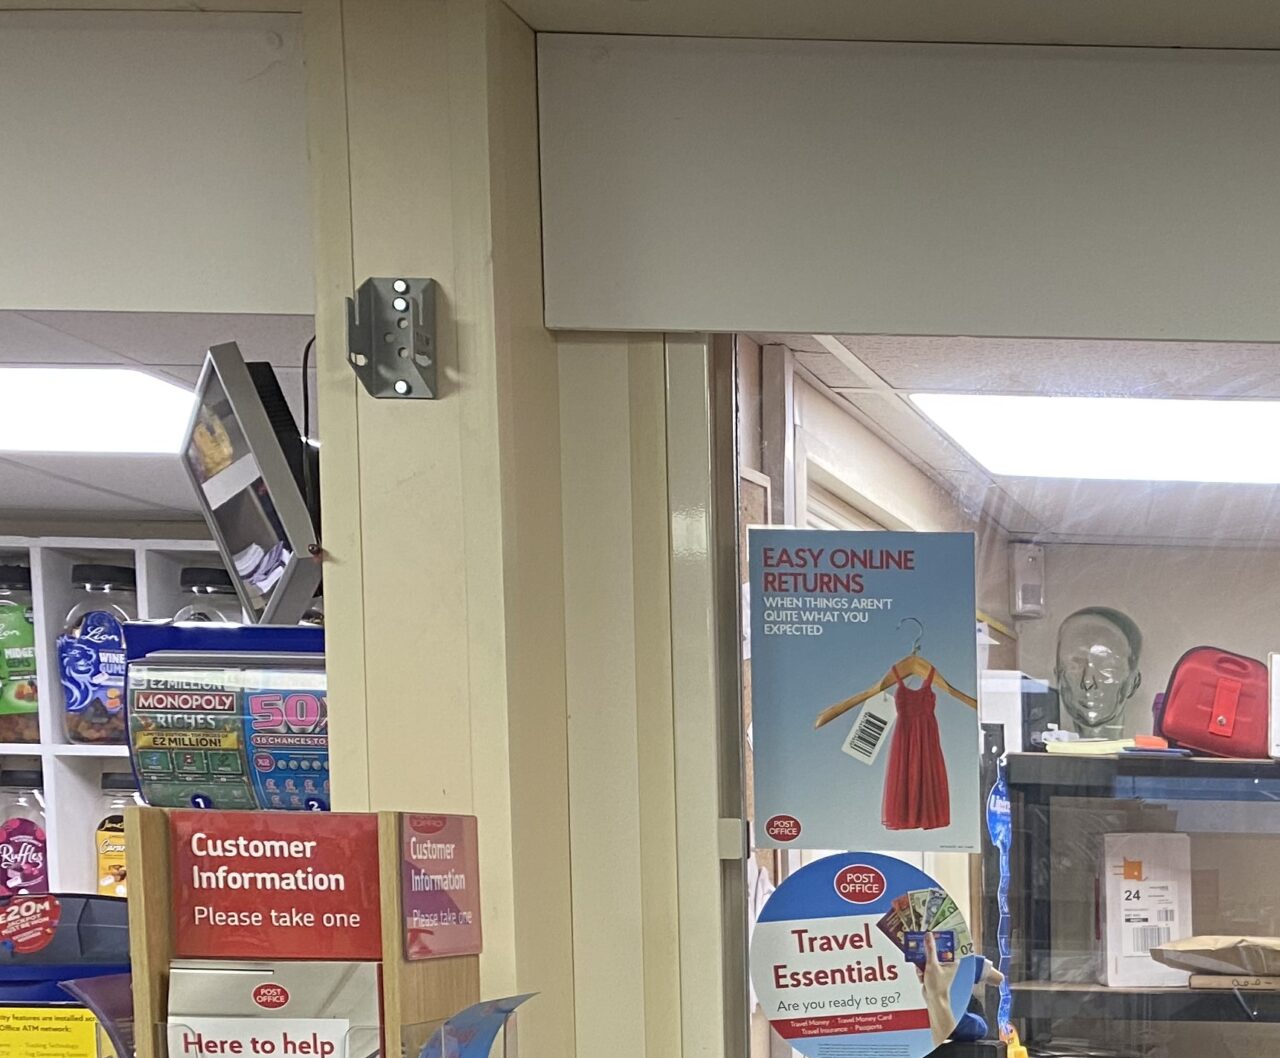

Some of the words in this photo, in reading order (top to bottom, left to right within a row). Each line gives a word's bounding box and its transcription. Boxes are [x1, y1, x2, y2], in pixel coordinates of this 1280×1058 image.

[762, 547, 825, 569] EASY
[829, 548, 916, 571] ONLINE
[762, 572, 865, 595] RETURNS
[763, 597, 802, 610] WHEN
[805, 597, 848, 610] THINGS
[850, 598, 893, 611] AREN'T
[763, 611, 799, 623] QUITE
[800, 611, 840, 624] WHAT
[842, 611, 869, 624] YOU
[81, 627, 120, 644] Lion
[763, 624, 823, 637] EXPECTED
[99, 652, 126, 664] WINE
[137, 694, 234, 711] MONOPOLY
[156, 714, 216, 730] RICHES
[168, 737, 222, 748] MILLION!
[267, 736, 311, 746] CHANCES
[768, 827, 798, 837] OFFICE
[773, 820, 796, 829] POST
[191, 833, 317, 860] Customer
[410, 837, 456, 860] Customer
[192, 866, 346, 892] Information
[411, 869, 466, 892] Information
[846, 873, 876, 884] POST
[840, 882, 880, 895] OFFICE
[1124, 889, 1142, 901] 24
[194, 906, 263, 928] Please
[270, 906, 315, 928] take
[322, 913, 361, 929] one
[413, 909, 439, 928] Please
[440, 908, 458, 926] take
[791, 923, 873, 954] Travel
[773, 956, 899, 989] Essentials
[255, 994, 287, 1004] OFFICE
[259, 988, 282, 997] POST
[777, 1000, 799, 1013] Are
[803, 998, 827, 1014] you
[828, 994, 862, 1012] ready
[865, 995, 878, 1006] to
[881, 992, 902, 1010] go?
[790, 1019, 808, 1028] Travel
[183, 1031, 244, 1055] Here
[250, 1037, 276, 1055] to
